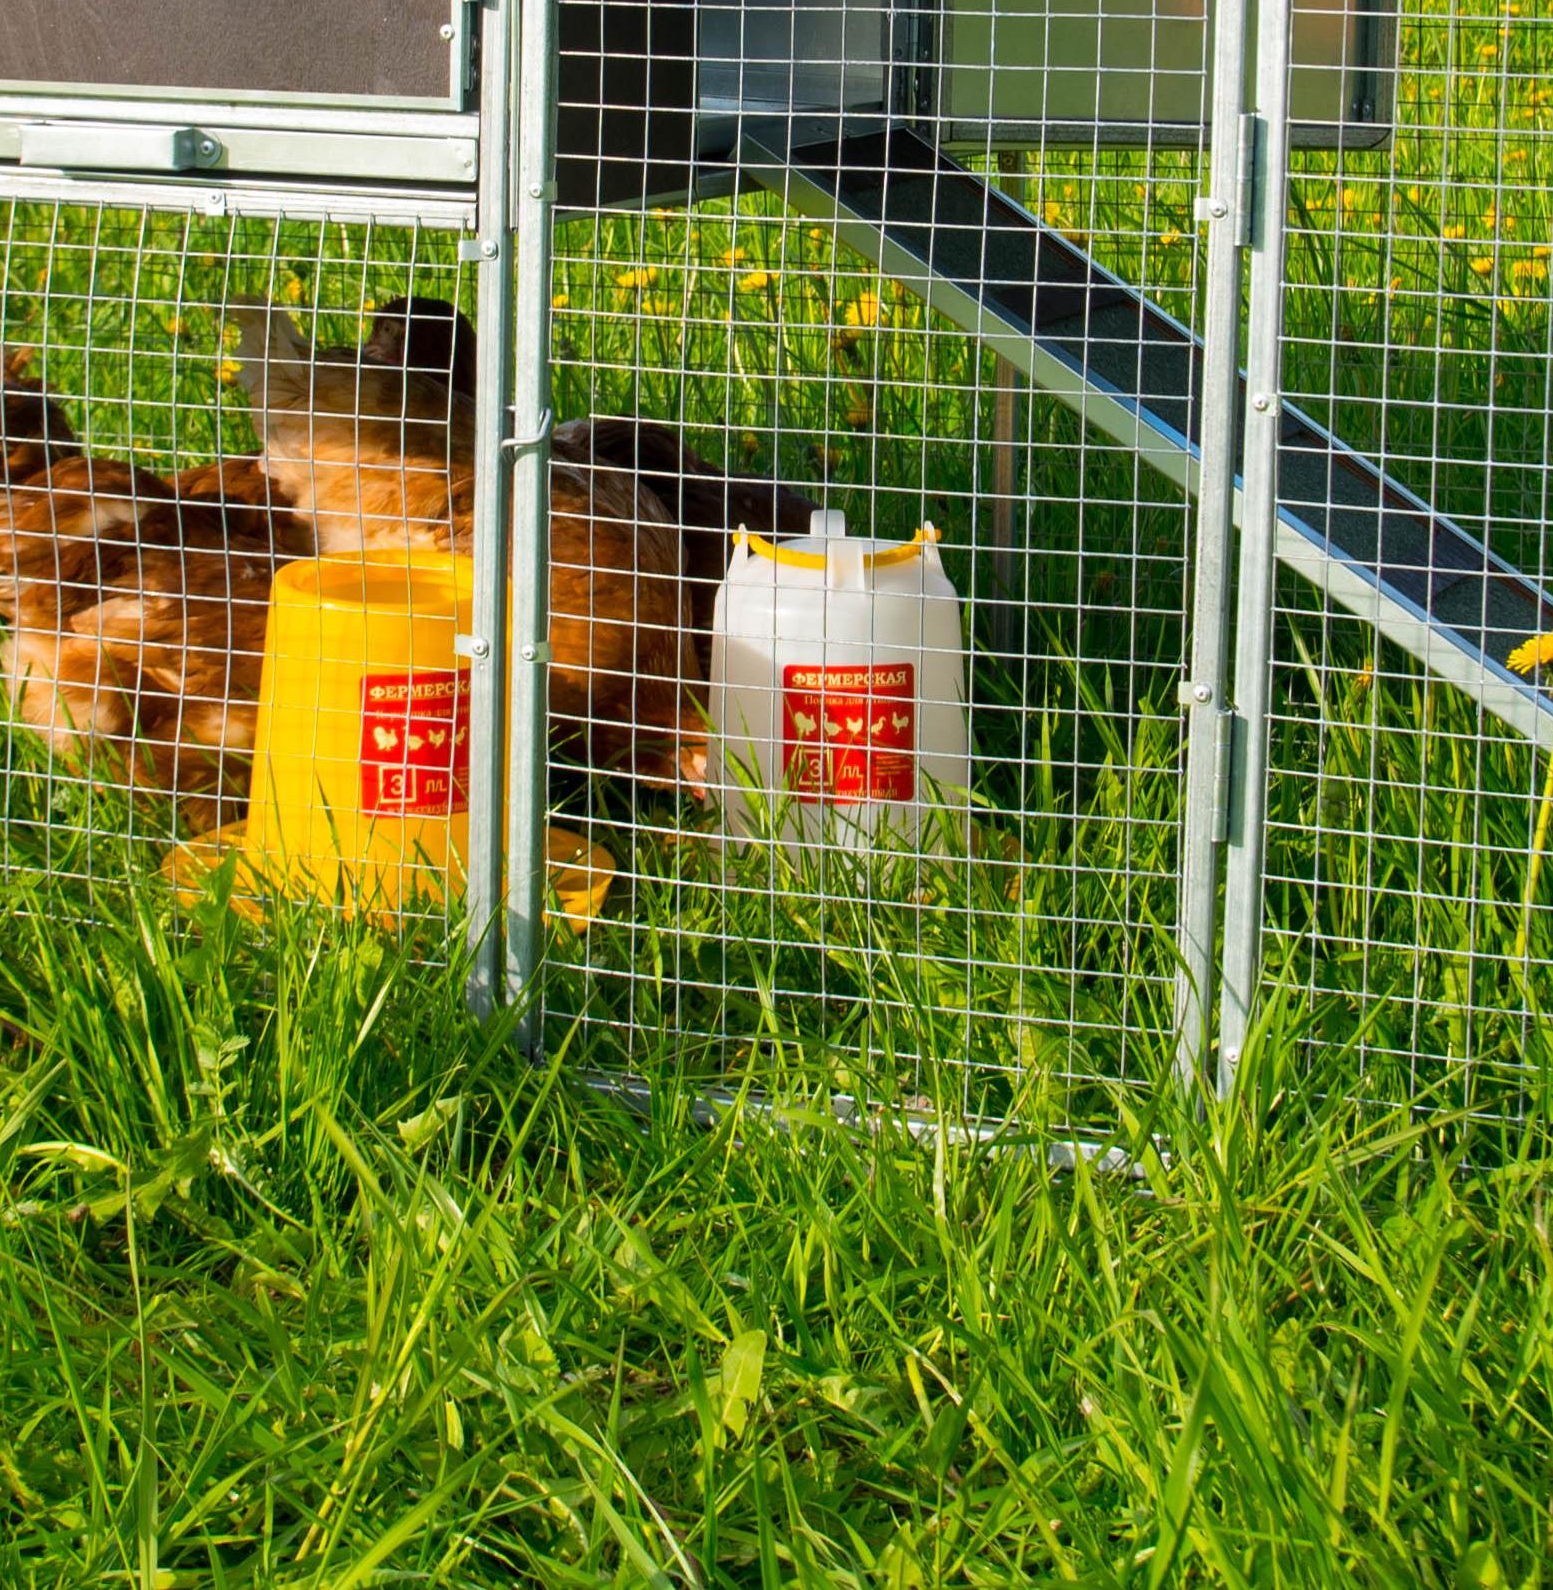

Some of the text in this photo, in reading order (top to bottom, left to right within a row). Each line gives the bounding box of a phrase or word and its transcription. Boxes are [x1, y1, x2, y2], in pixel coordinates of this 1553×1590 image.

[792, 671, 907, 687] ФЕРМЕРСКАЯ
[810, 759, 823, 777] 3
[390, 774, 403, 795] 3
